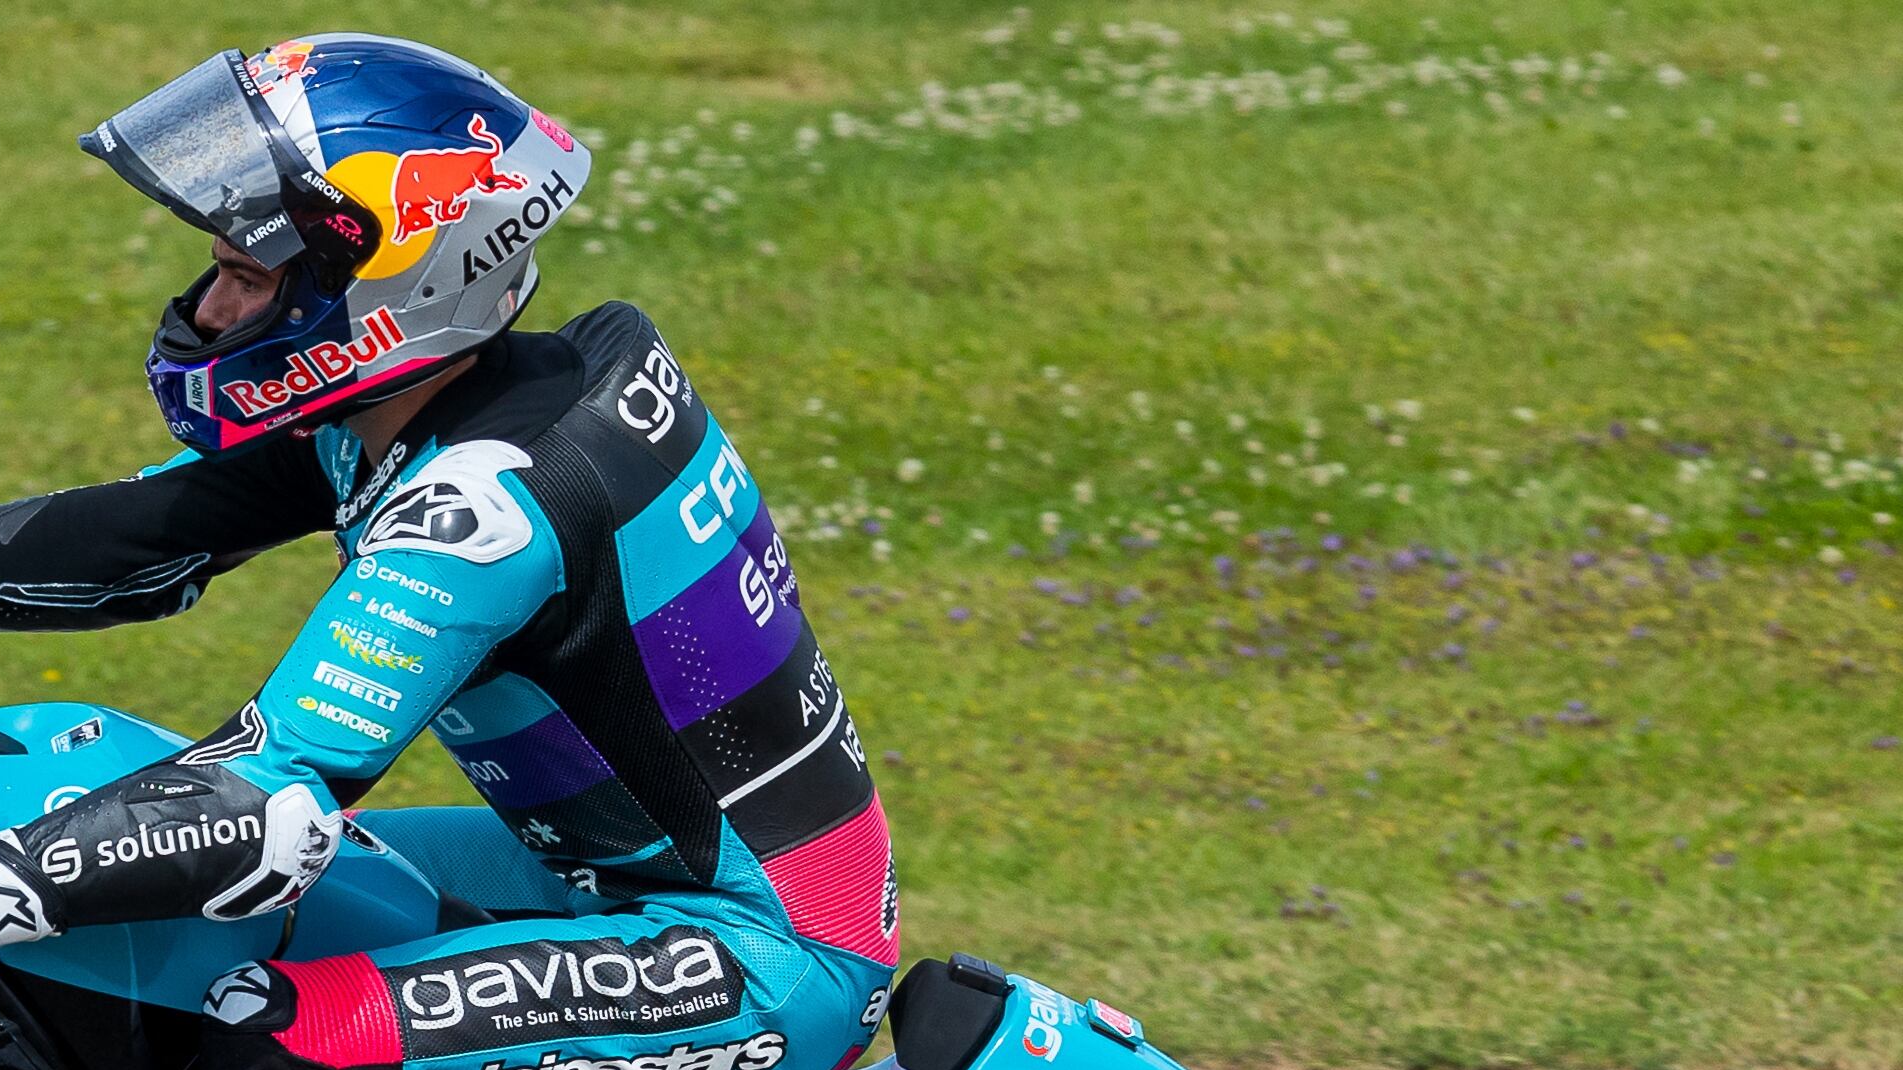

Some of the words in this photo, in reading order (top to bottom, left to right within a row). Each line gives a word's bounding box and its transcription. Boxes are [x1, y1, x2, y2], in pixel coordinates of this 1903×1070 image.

[301, 171, 344, 203] AIROH
[245, 214, 288, 248] AIROH
[462, 169, 574, 287] AIROH
[220, 353, 324, 418] Red
[305, 305, 408, 383] Bull
[192, 374, 203, 411] AIROH
[678, 429, 748, 544] CFM
[376, 564, 453, 607] CFMOTO
[329, 621, 403, 656] ANGEL
[365, 597, 381, 614] le
[379, 603, 438, 639] Cabanon
[312, 660, 402, 712] PIRELLI
[316, 701, 392, 744] MOTOREX
[96, 813, 262, 868] solunion
[402, 936, 725, 1031] gaviota
[491, 1014, 524, 1031] The
[527, 1008, 561, 1026] Sun
[564, 1008, 577, 1022] &
[578, 1005, 638, 1022] Shutter
[640, 991, 730, 1023] Specialists
